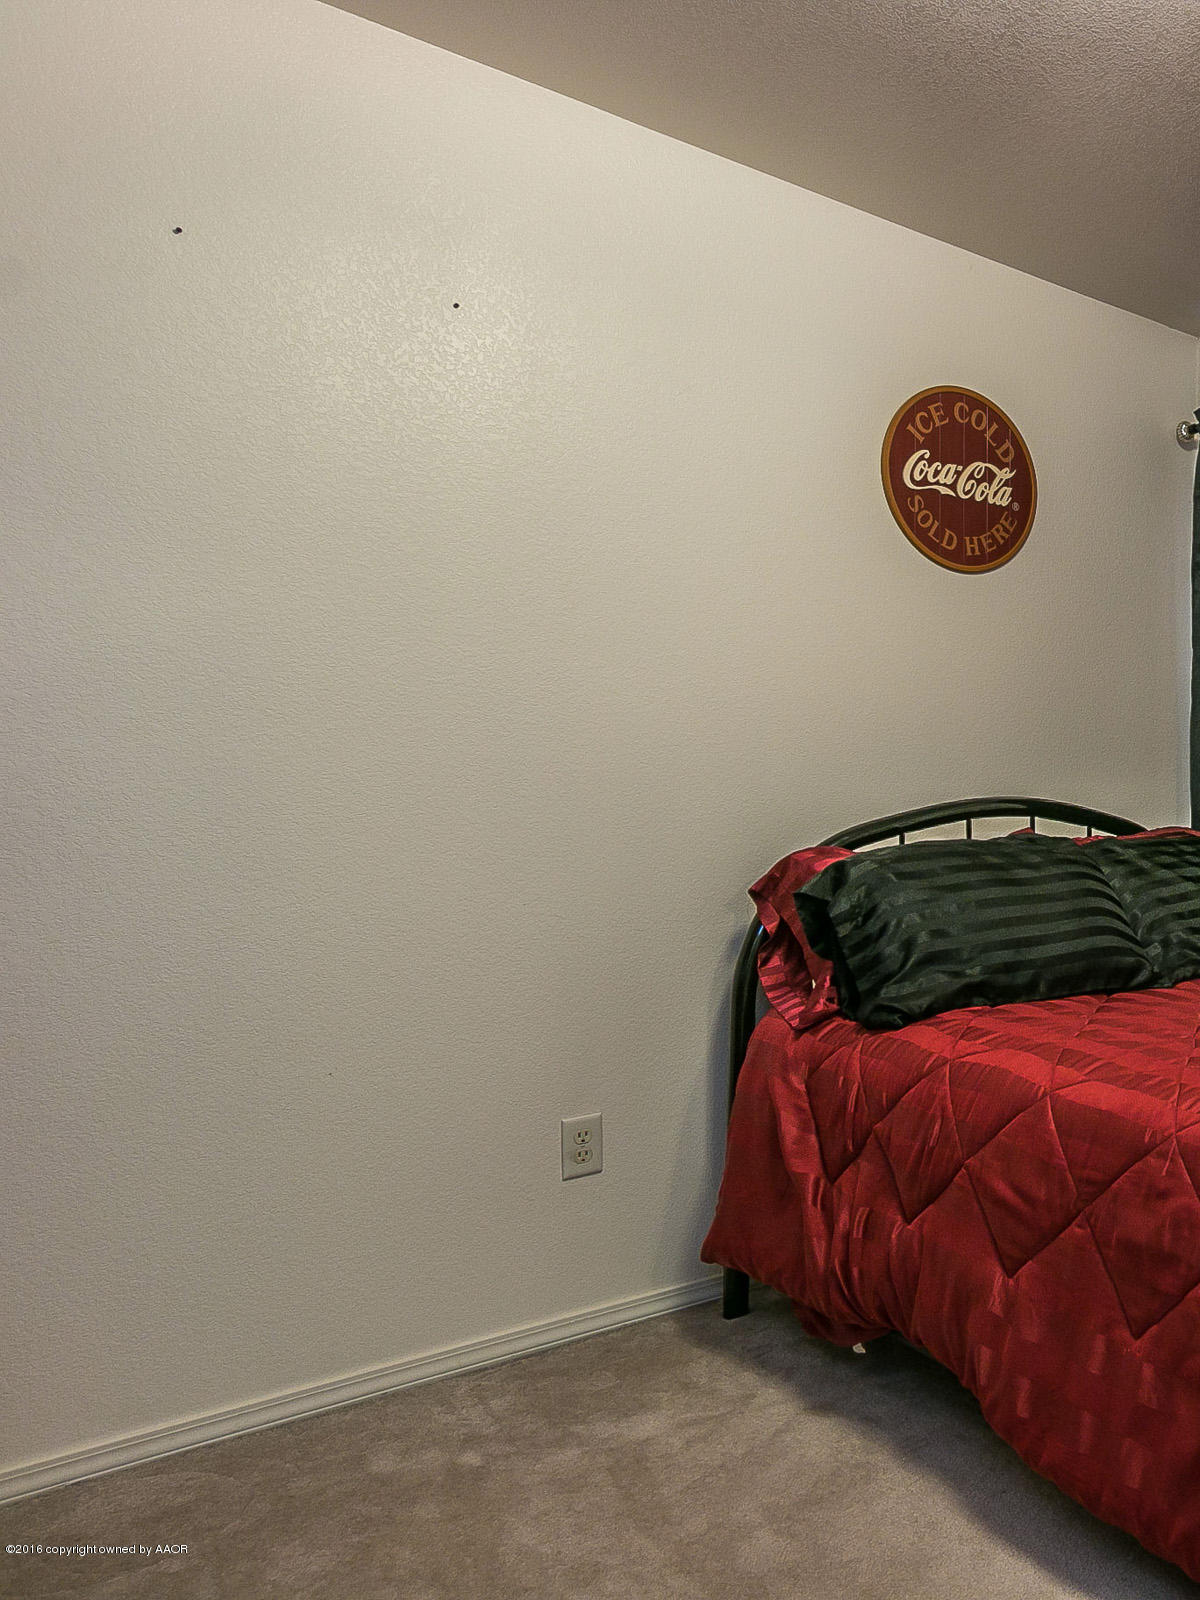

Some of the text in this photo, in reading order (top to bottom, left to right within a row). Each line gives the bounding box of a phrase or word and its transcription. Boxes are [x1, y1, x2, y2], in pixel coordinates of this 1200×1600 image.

[906, 401, 1015, 463] ICE COLD
[902, 449, 1017, 507] Coca-Cola
[907, 494, 1018, 556] SOLD HERE
